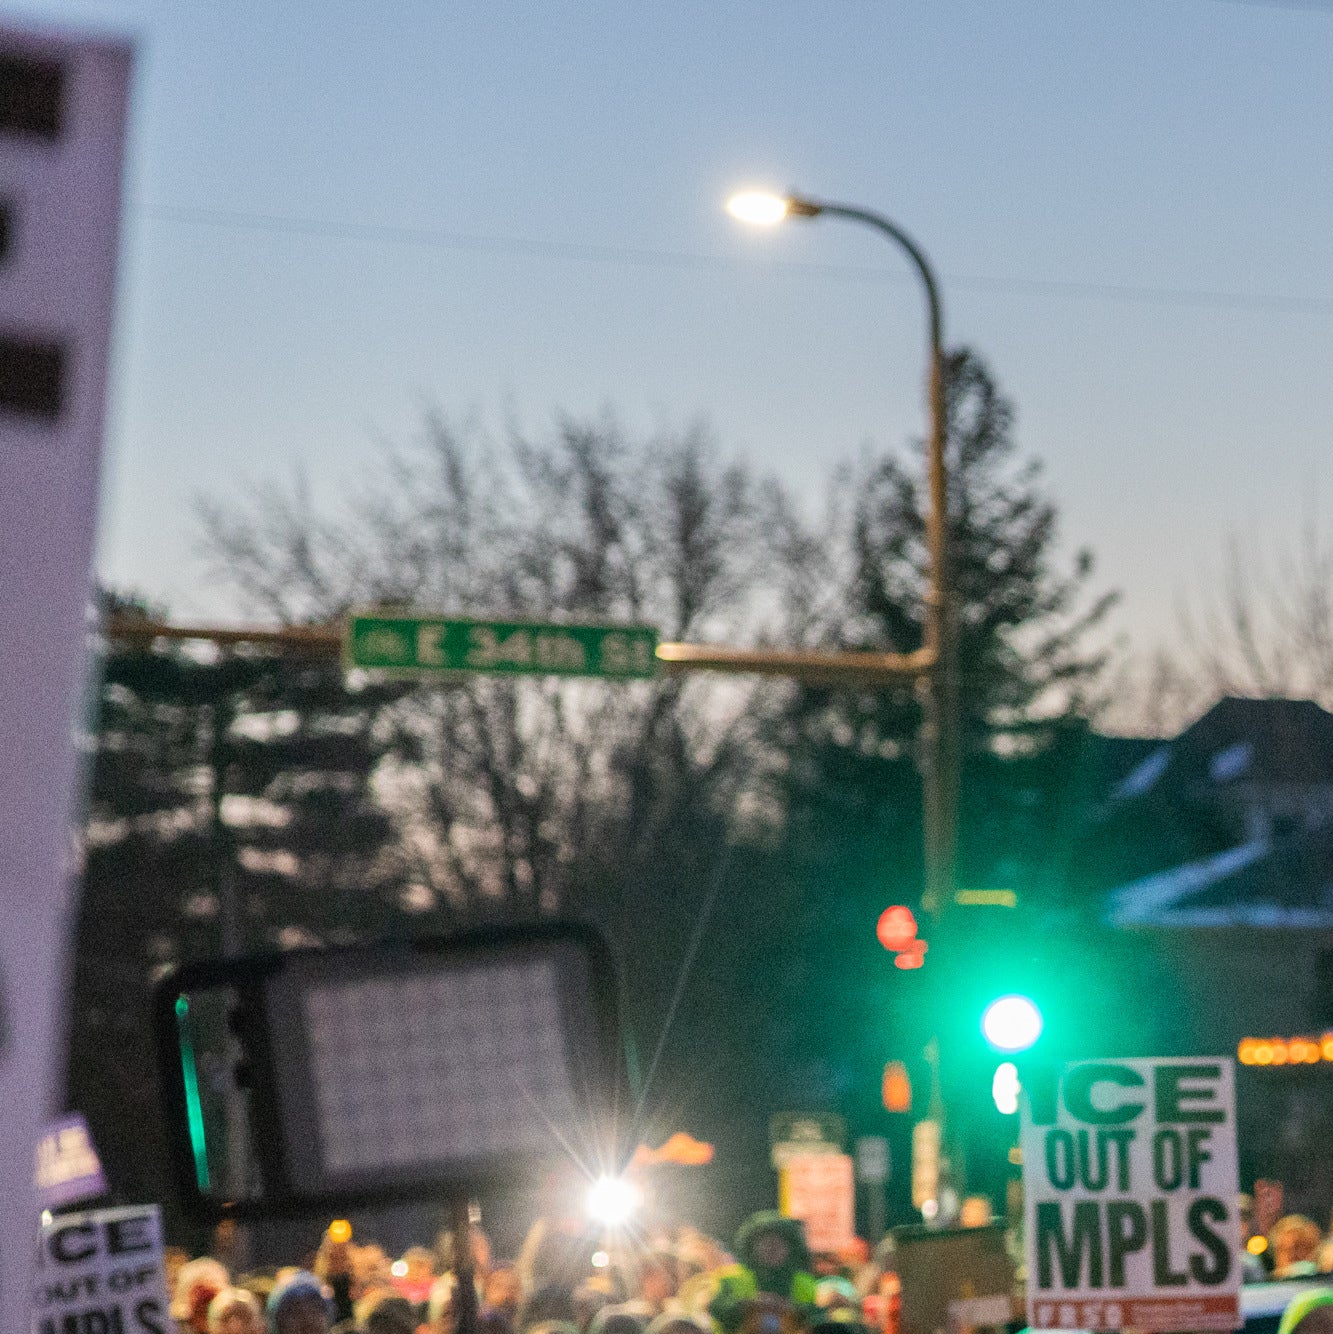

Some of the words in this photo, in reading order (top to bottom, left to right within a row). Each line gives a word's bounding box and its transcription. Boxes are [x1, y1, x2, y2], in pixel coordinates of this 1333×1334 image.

[416, 623, 446, 666] E
[464, 626, 587, 669] 34th
[1028, 1063, 1226, 1126] ICE
[1045, 1129, 1137, 1193] OUT
[1153, 1129, 1212, 1192] OF
[1035, 1194, 1232, 1289] MPLS
